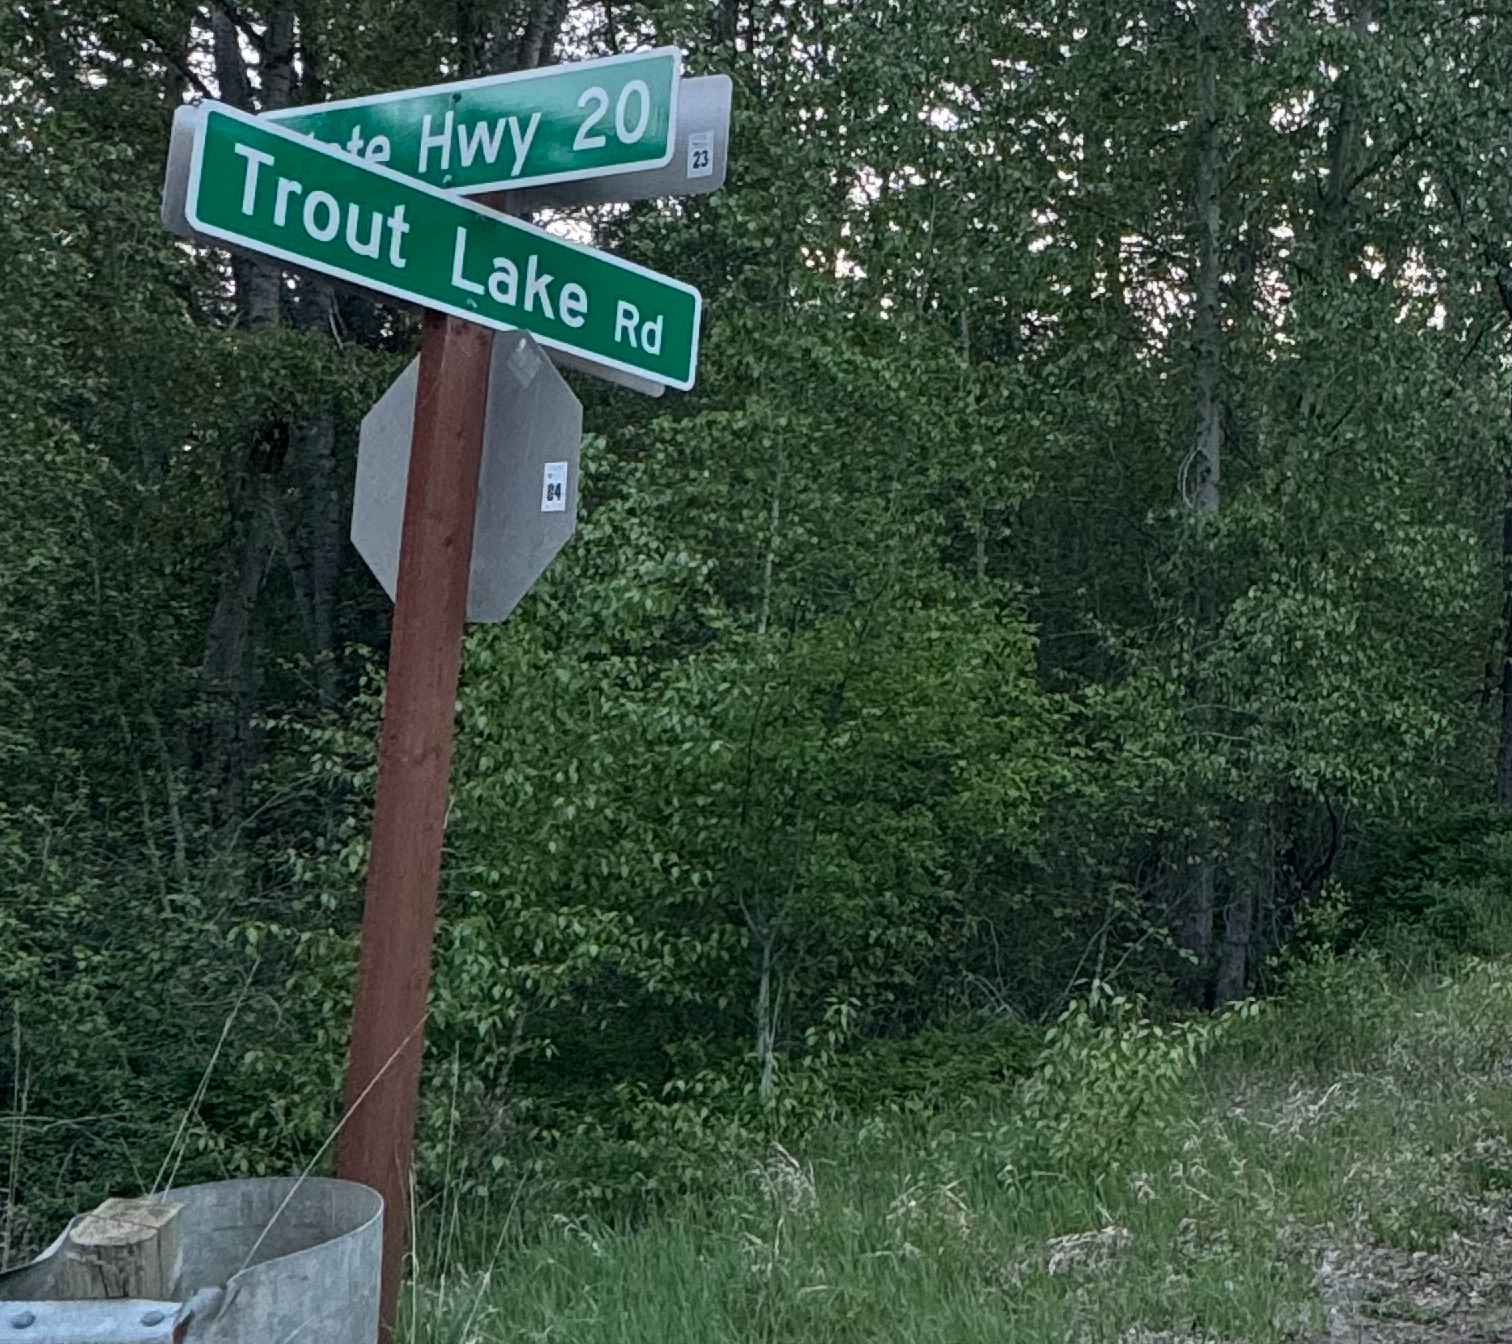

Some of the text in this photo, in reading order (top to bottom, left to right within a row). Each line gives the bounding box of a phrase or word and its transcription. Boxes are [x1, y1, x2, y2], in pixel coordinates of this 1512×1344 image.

[418, 110, 541, 176] Hwy
[573, 80, 650, 151] 20
[692, 150, 709, 169] 23
[233, 143, 663, 355] Trout Lake Rd
